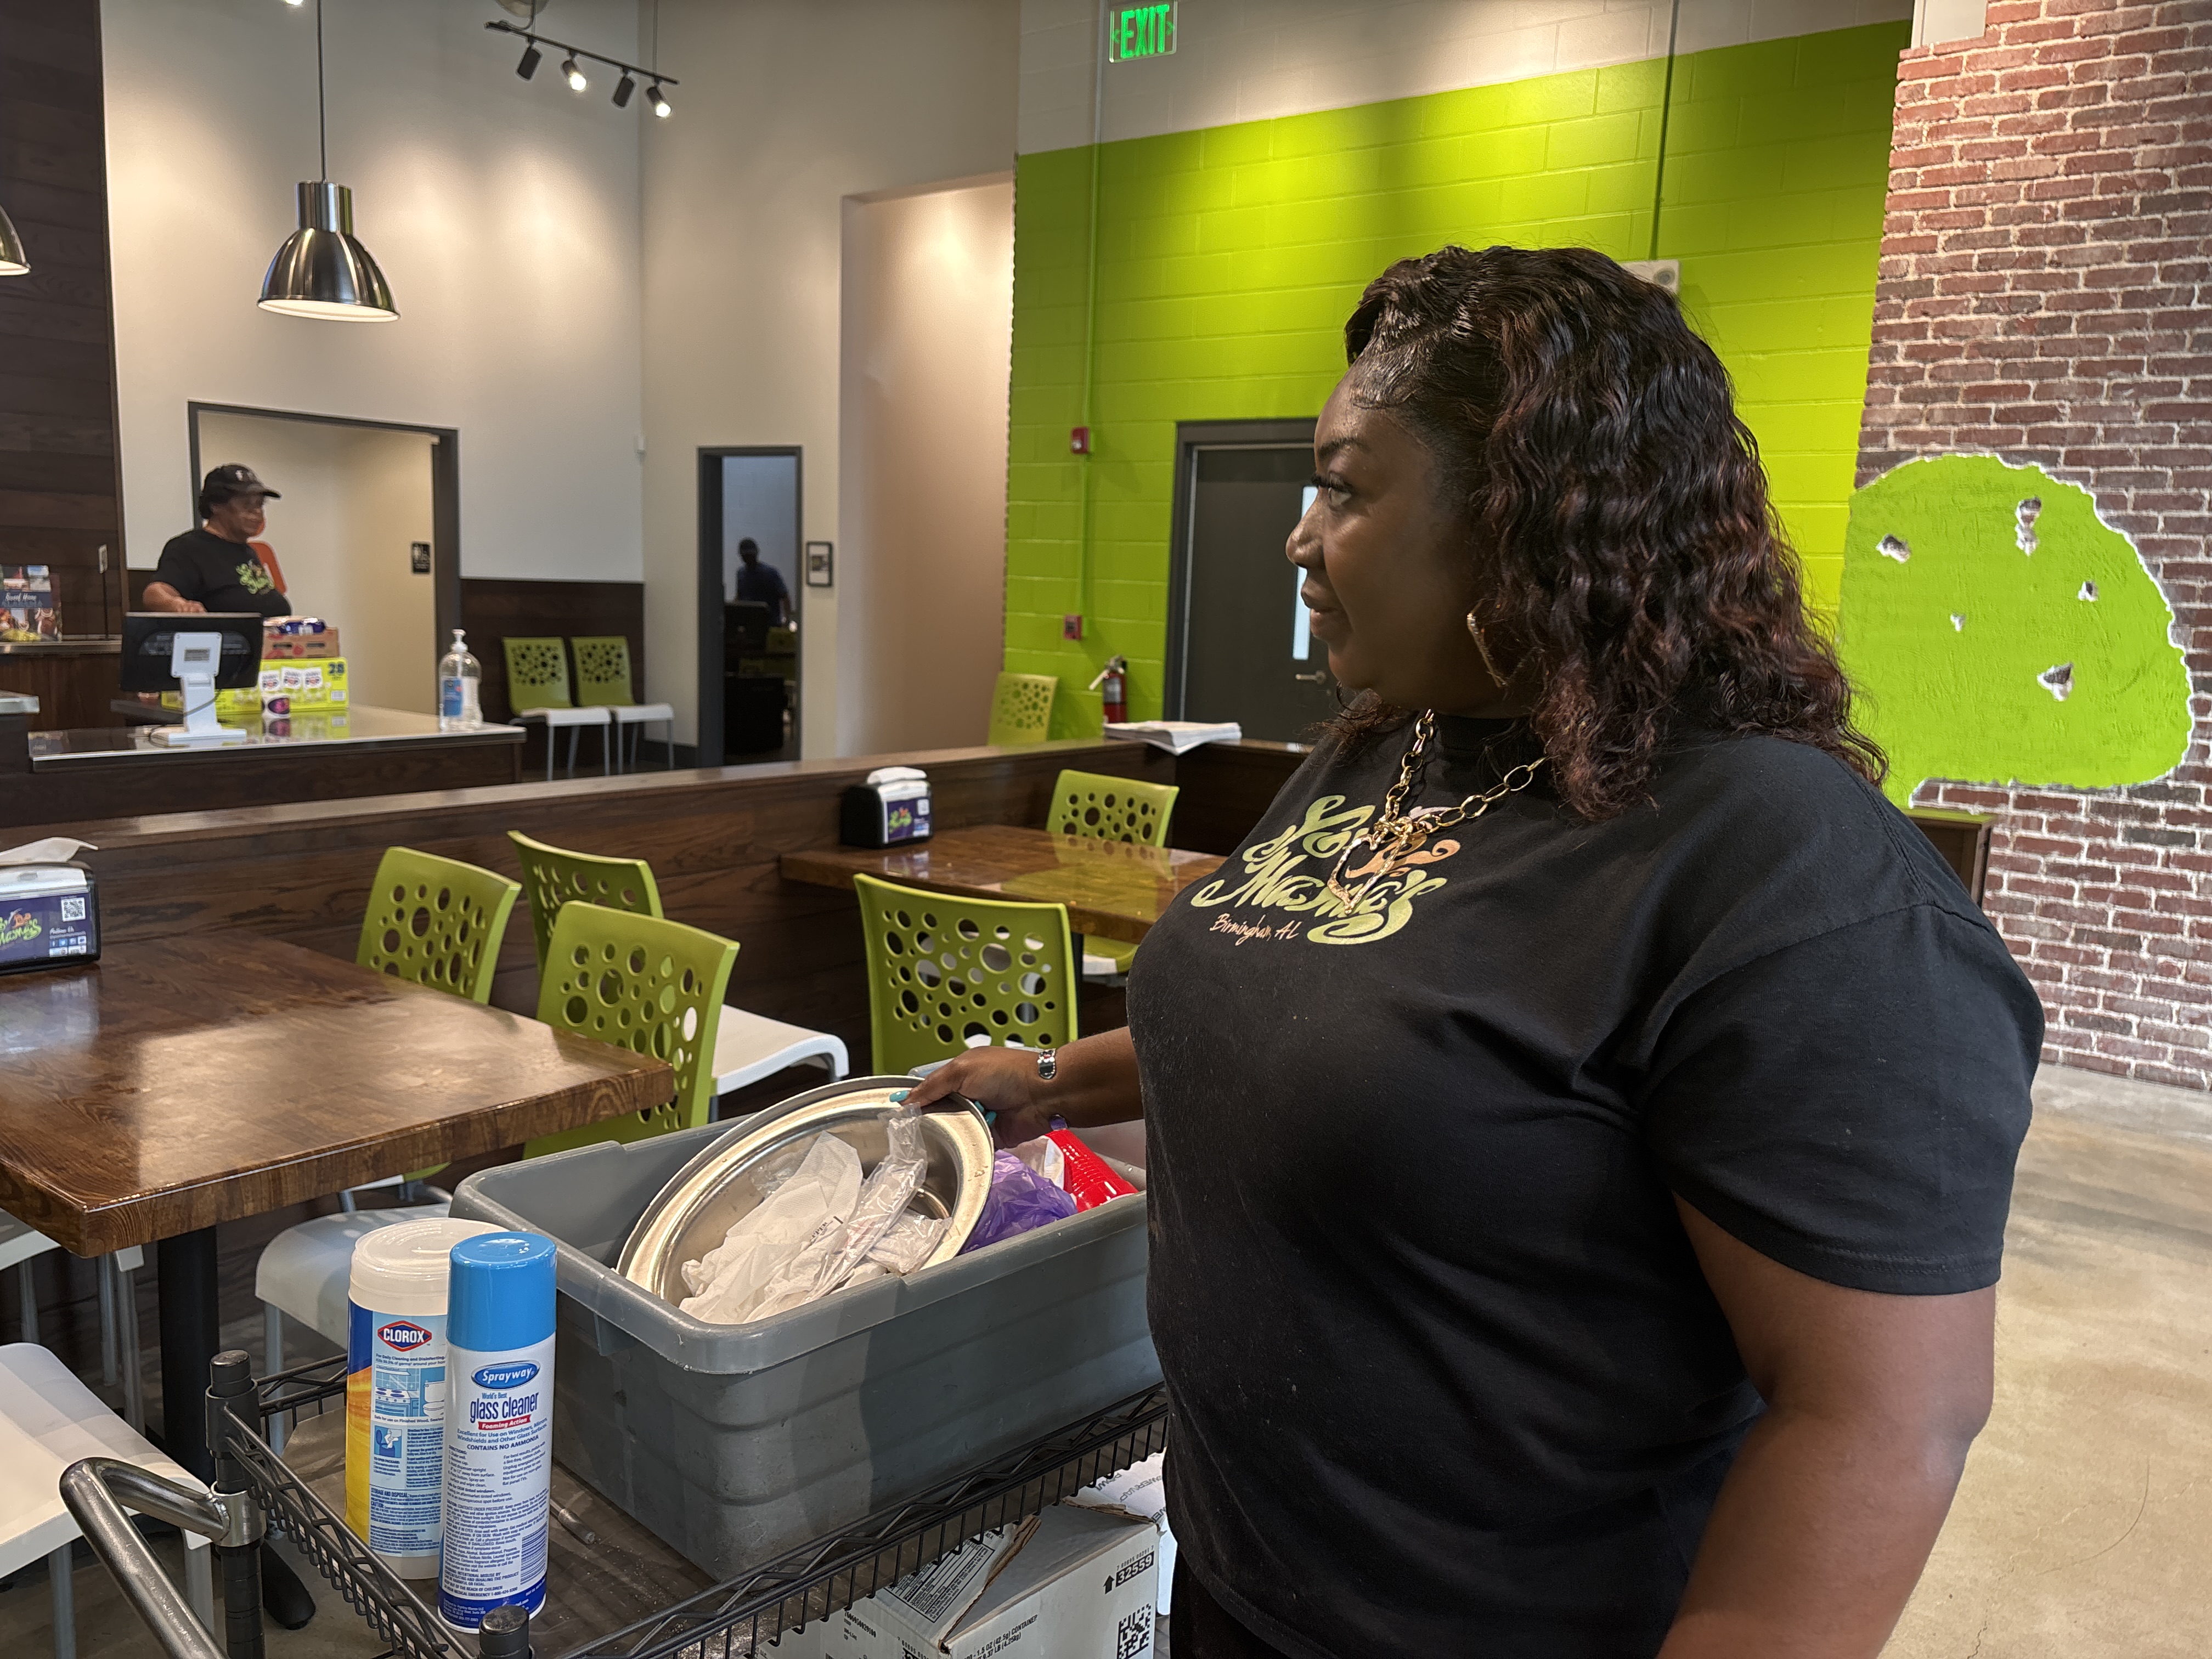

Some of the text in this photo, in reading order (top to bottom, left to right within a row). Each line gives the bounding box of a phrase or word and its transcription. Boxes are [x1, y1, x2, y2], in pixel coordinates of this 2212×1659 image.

[1120, 4, 1170, 59] EXIT
[23, 592, 36, 601] Home
[328, 663, 345, 675] 28
[1209, 913, 1302, 946] Birmingham, AL
[383, 1328, 425, 1343] CLOROX
[482, 1368, 533, 1384] Sprayway
[470, 1392, 539, 1423] glass cleaner
[509, 1418, 527, 1426] Action
[457, 1428, 478, 1437] Excellent
[457, 1435, 487, 1443] Windshields
[511, 1435, 539, 1448] AMMONIA
[518, 1458, 534, 1466] energized
[1120, 1475, 1161, 1502] OWERNAP
[1118, 1555, 1152, 1583] 32559
[904, 1584, 918, 1600] Protein
[913, 1592, 927, 1606] Calcium
[921, 1593, 939, 1612] Potassium
[977, 1647, 985, 1656] 1.5
[986, 1641, 993, 1651] OZ
[993, 1630, 1011, 1647] (42.5g)
[983, 1649, 994, 1659] 9.37
[994, 1644, 1001, 1654] LB
[1002, 1632, 1022, 1650] (4.25kg)
